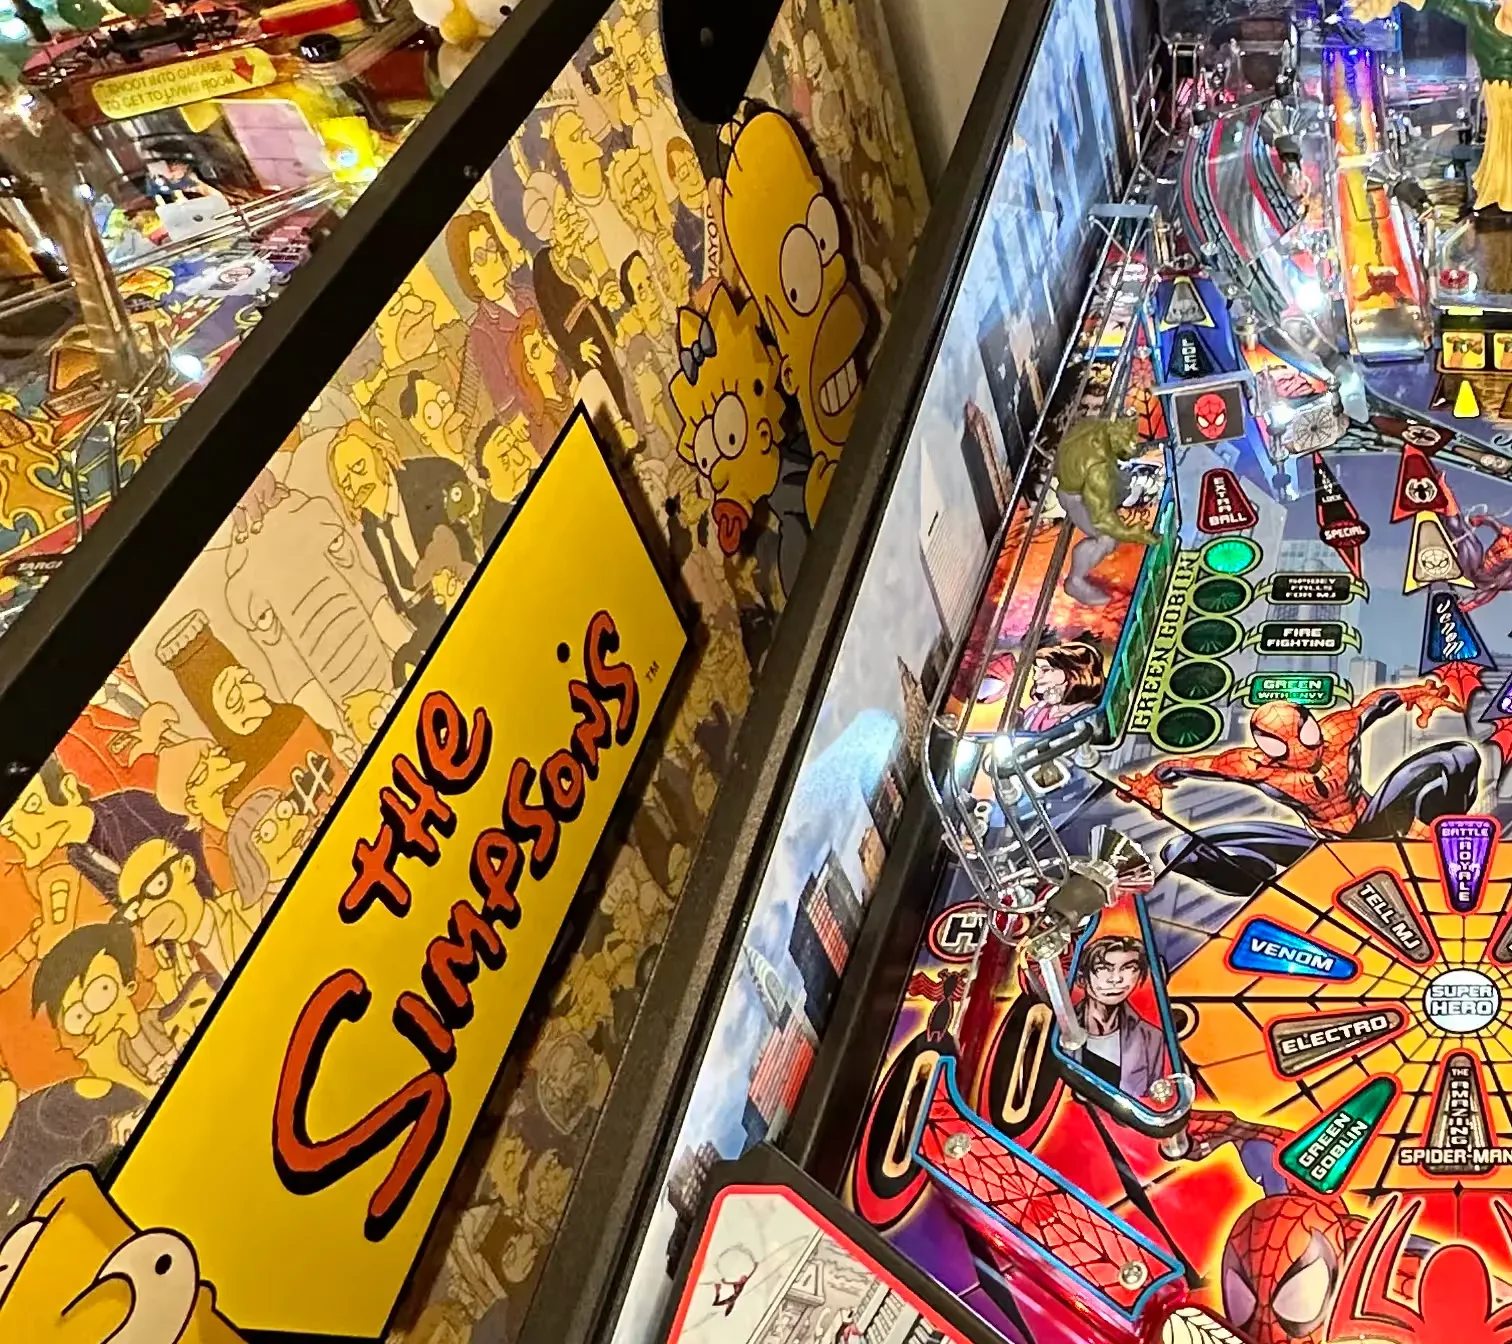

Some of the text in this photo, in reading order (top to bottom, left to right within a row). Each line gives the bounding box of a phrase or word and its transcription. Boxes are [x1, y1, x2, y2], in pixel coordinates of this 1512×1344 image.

[122, 94, 145, 107] GET
[147, 90, 163, 103] TO
[201, 76, 235, 89] ROOM
[1213, 476, 1233, 513] EXTRA
[1208, 512, 1247, 527] BALL
[1324, 525, 1366, 540] SPECIAL
[1266, 638, 1335, 648] FIGHTING
[1283, 628, 1322, 637] FIRE
[1132, 650, 1171, 730] GREEN
[1263, 679, 1322, 690] GREEN
[1441, 827, 1489, 837] BATTLE
[1458, 838, 1472, 902] ROYALE
[1357, 882, 1421, 951] TELL MJ
[1250, 937, 1334, 972] VENOM
[1431, 984, 1493, 998] SUPER
[1430, 1000, 1493, 1016] HERO
[1281, 1014, 1389, 1055] ELECTRO
[1451, 1068, 1469, 1077] THE
[1450, 1080, 1470, 1146] AMAZING
[1299, 1111, 1352, 1168] GREEN
[1310, 1119, 1369, 1181] GOBLIN
